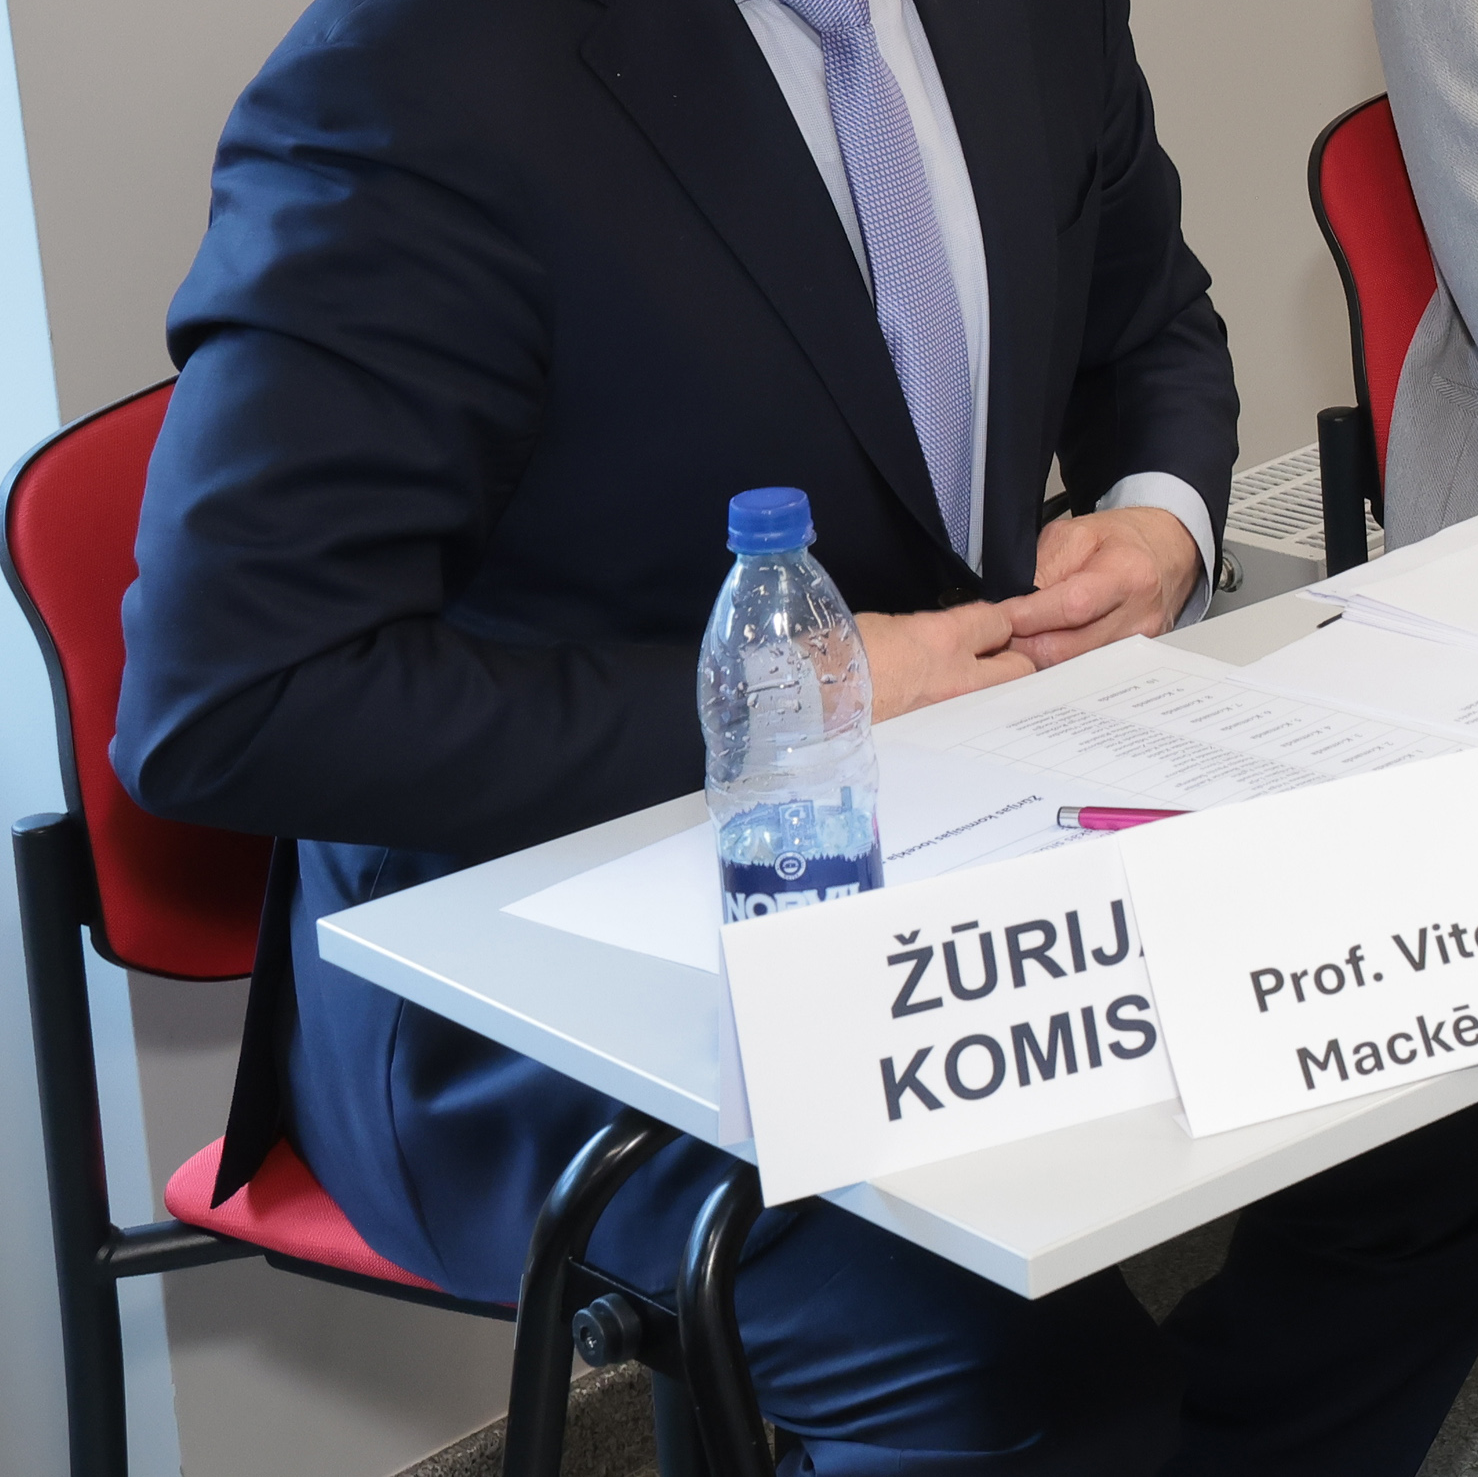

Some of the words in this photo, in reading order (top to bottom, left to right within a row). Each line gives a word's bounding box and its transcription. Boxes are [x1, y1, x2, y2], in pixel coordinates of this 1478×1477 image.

[886, 898, 1146, 1020] ŽŪRIJ
[1249, 945, 1384, 1014] Prof.
[879, 993, 1157, 1122] KOMIS
